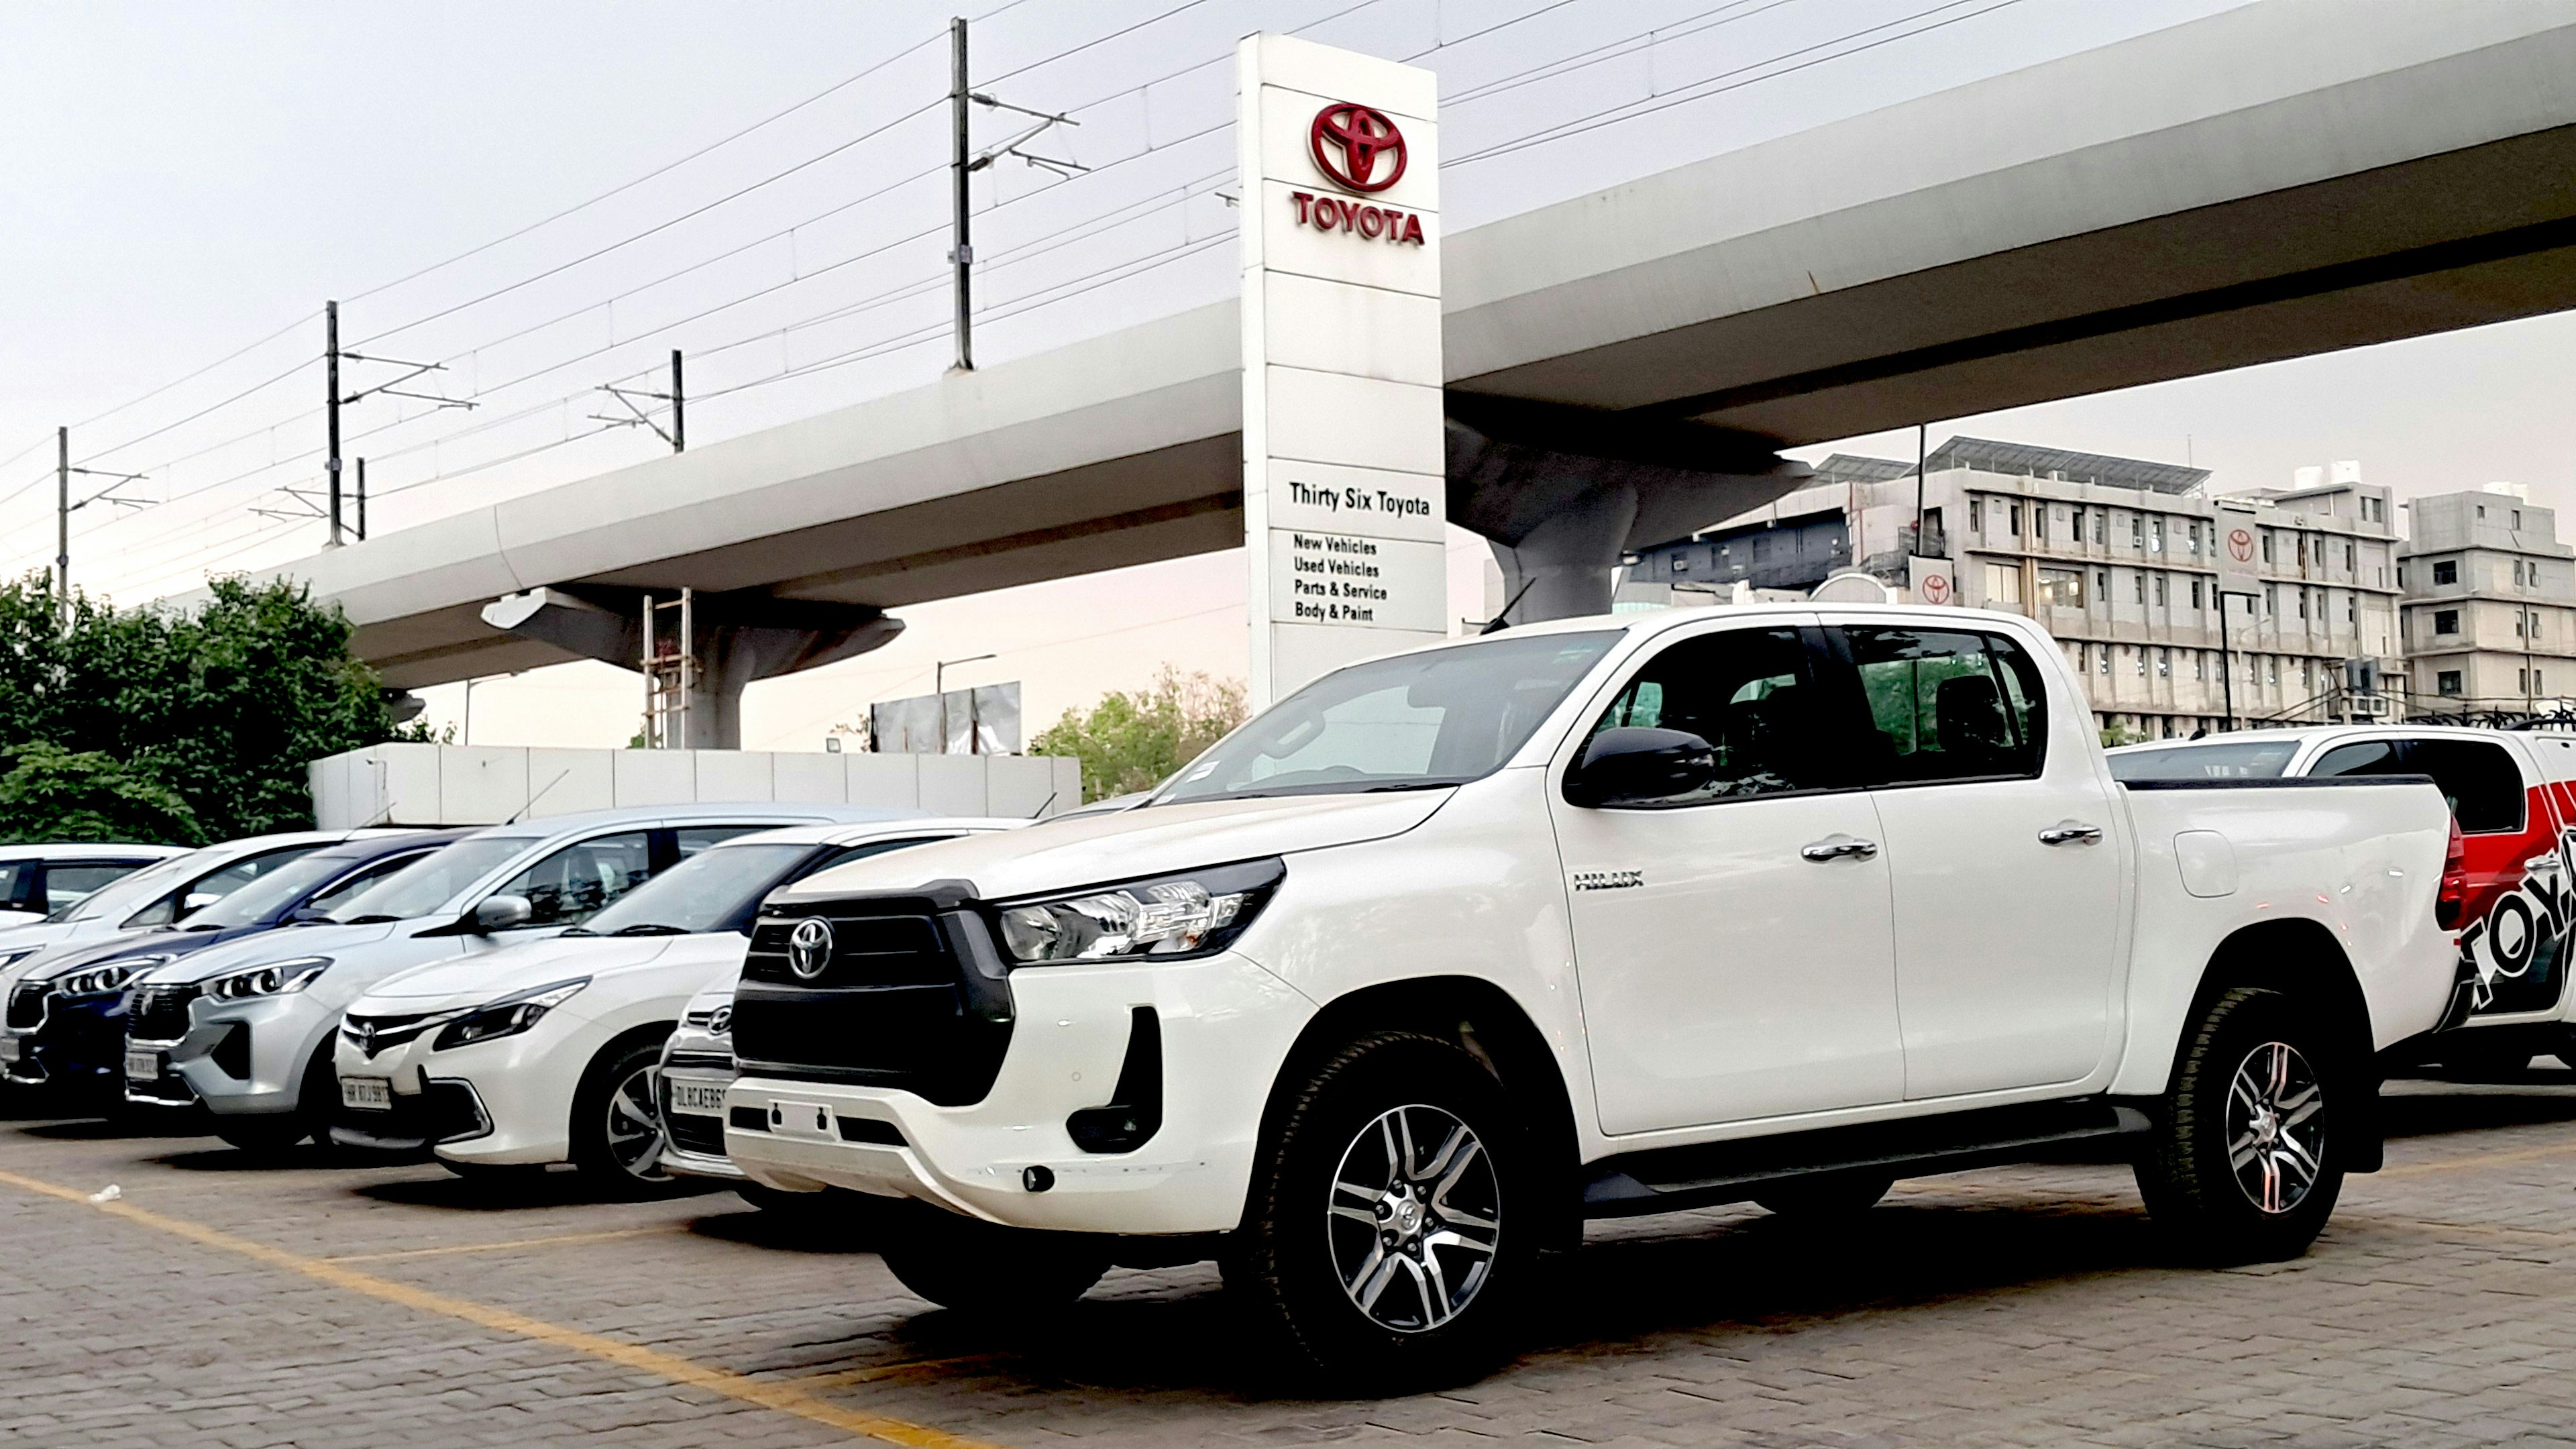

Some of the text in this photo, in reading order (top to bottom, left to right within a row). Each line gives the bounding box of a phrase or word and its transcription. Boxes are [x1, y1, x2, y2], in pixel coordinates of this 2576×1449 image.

[1293, 191, 1425, 246] TOYOTA
[1289, 482, 1430, 519] Thirty Six Toyota
[1294, 534, 1377, 555] New Vehicles
[1294, 556, 1379, 578] Used Vehicles
[1295, 579, 1387, 600] Parts & Service
[1295, 602, 1374, 623] Body & Paint
[1574, 871, 1644, 891] HILUX
[2461, 830, 2576, 1010] TOY
